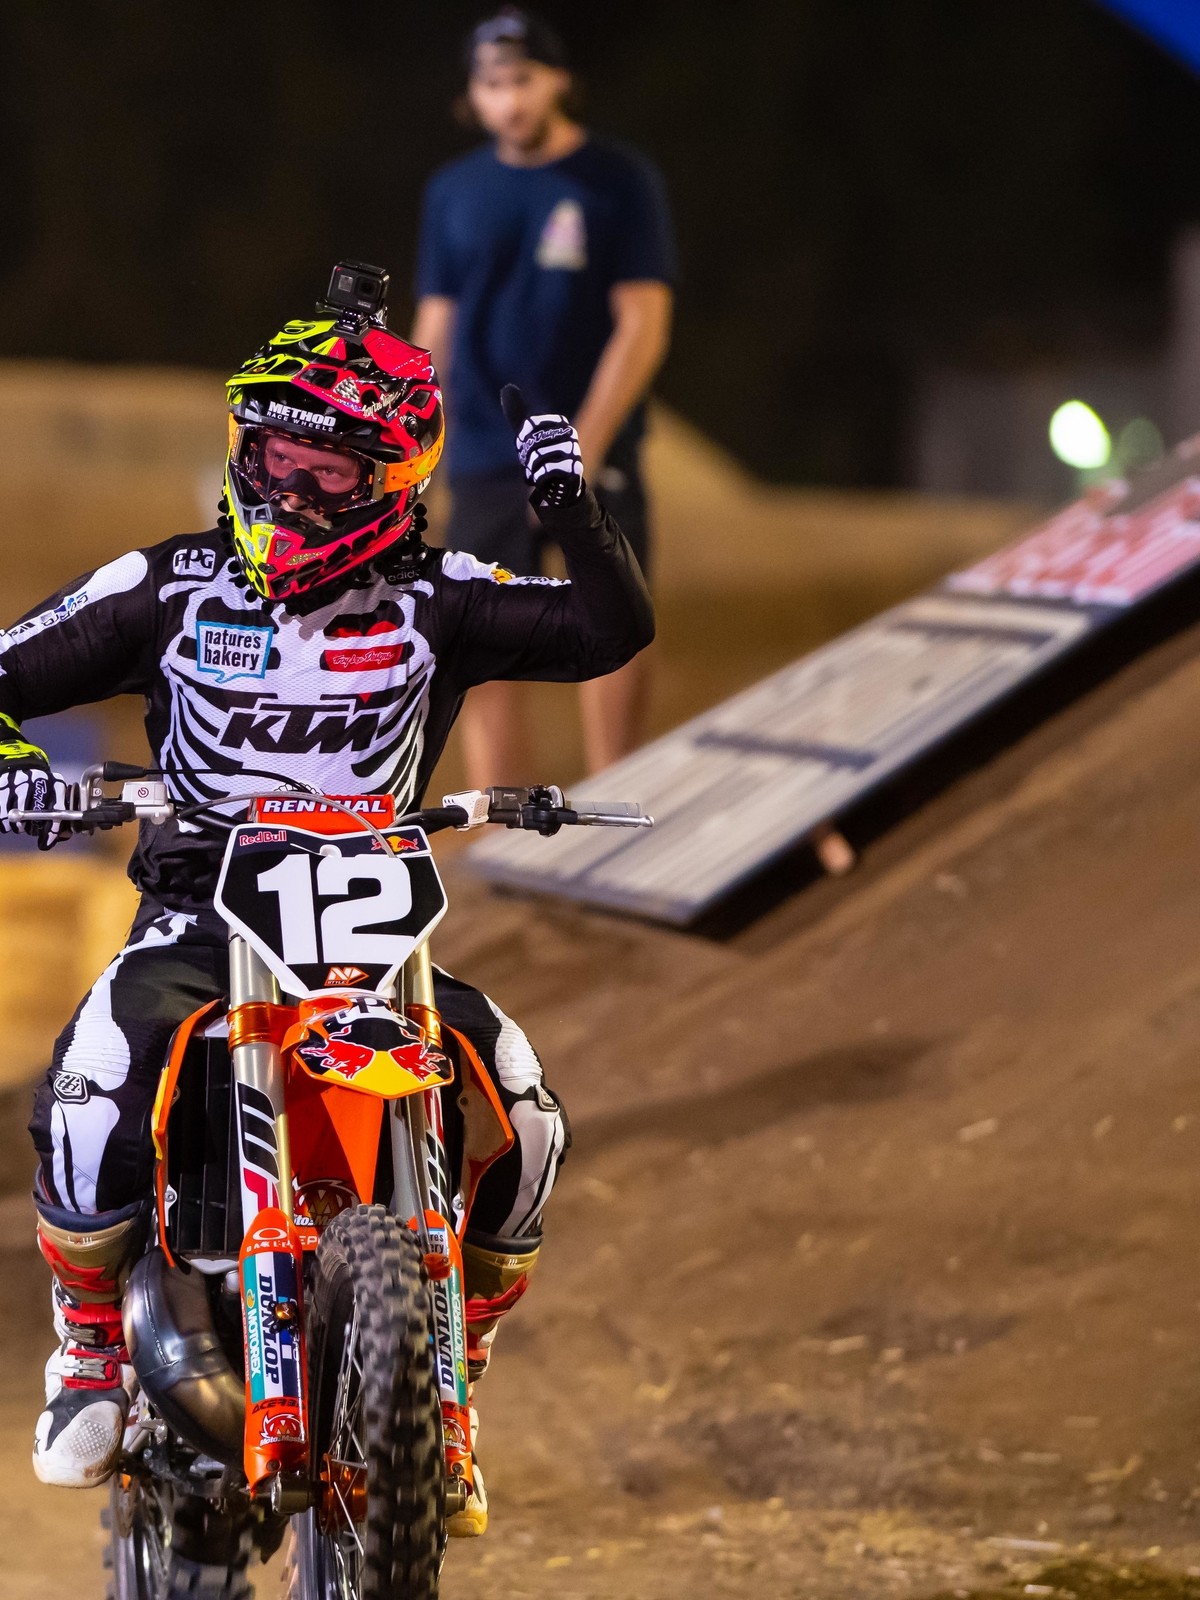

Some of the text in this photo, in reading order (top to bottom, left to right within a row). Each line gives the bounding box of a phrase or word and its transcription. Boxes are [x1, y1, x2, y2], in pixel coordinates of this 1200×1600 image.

[267, 411, 334, 432] RACE WHEELS
[268, 401, 337, 427] METHOD
[174, 549, 215, 570] PPG
[388, 570, 420, 581] adid
[204, 629, 261, 649] nature's
[204, 647, 260, 670] bakery
[219, 704, 381, 754] KTM
[263, 799, 387, 813] RENTHAL
[257, 853, 416, 964] 12
[259, 1273, 280, 1385] DUNLOP
[434, 1280, 455, 1391] DUNLOP
[451, 1291, 465, 1361] MOTOREX
[247, 1308, 261, 1378] MOTOREX
